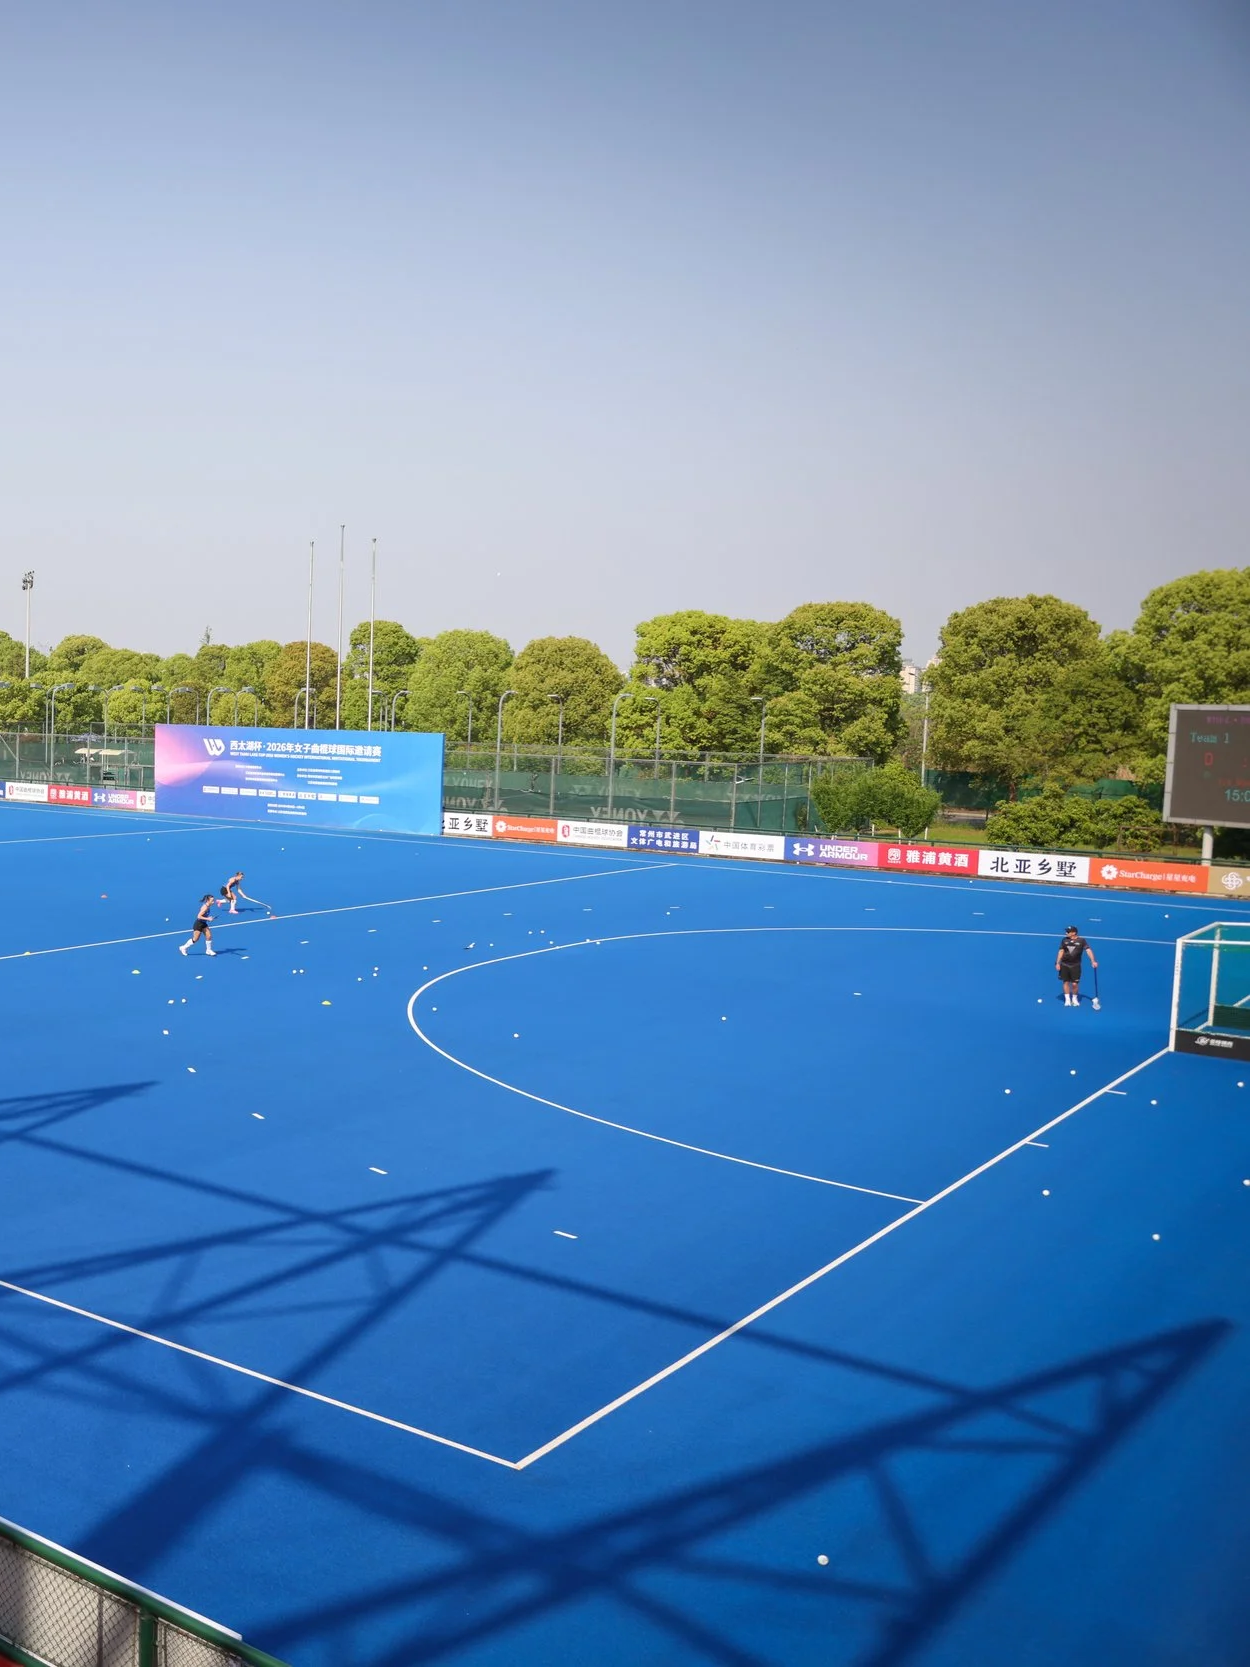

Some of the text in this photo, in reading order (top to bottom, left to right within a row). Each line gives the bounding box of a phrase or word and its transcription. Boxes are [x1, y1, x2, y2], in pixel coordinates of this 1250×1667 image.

[573, 826, 623, 838] 中国曲棍球协会
[639, 829, 689, 841] 常州市武进区
[630, 837, 697, 850] 文体广电和旅游局
[724, 841, 775, 853] 中国体育彩票
[819, 844, 858, 853] UNDER
[819, 851, 868, 861] ARMOUR
[906, 849, 969, 868] 雅浦黄酒
[990, 856, 1077, 878] 北亚乡墅
[1119, 869, 1162, 881] StarCharge
